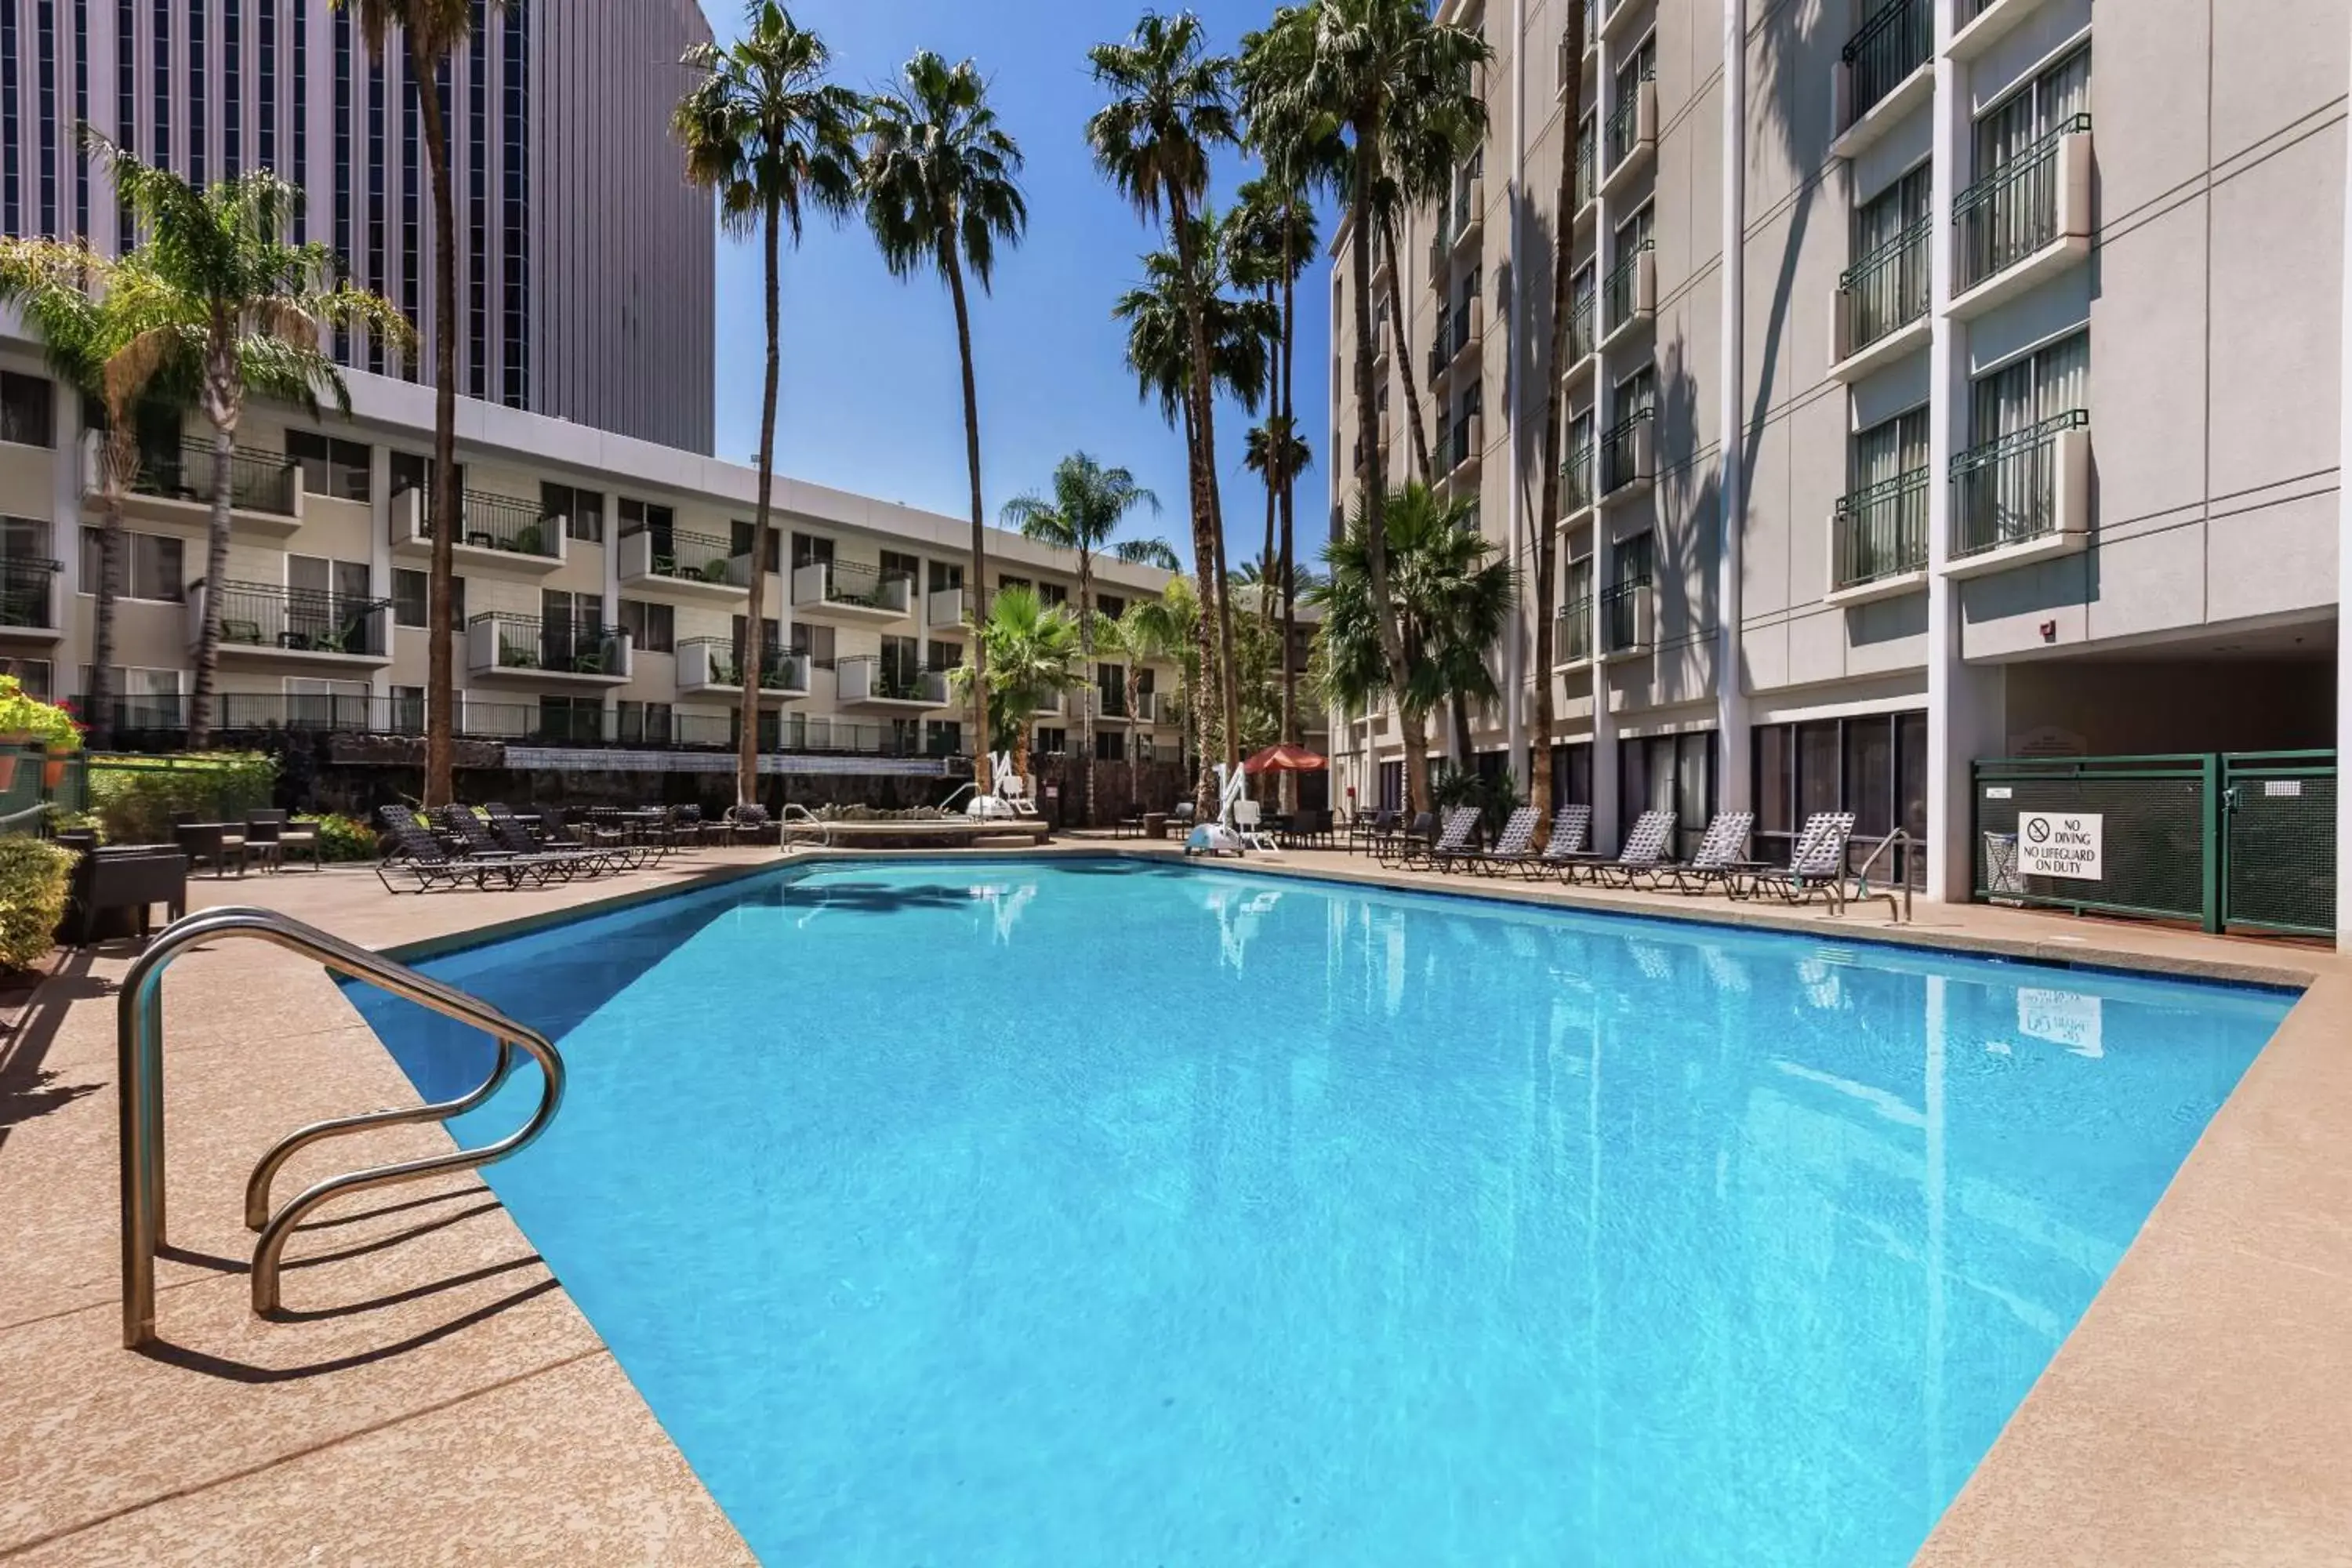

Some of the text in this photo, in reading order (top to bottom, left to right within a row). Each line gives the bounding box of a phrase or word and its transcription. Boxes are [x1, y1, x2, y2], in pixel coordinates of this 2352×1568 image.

[2064, 819, 2081, 831] NO
[2055, 832, 2091, 845] DIVING
[2024, 846, 2096, 862] NO LIFEGUARD
[2035, 858, 2082, 873] ON DUTY
